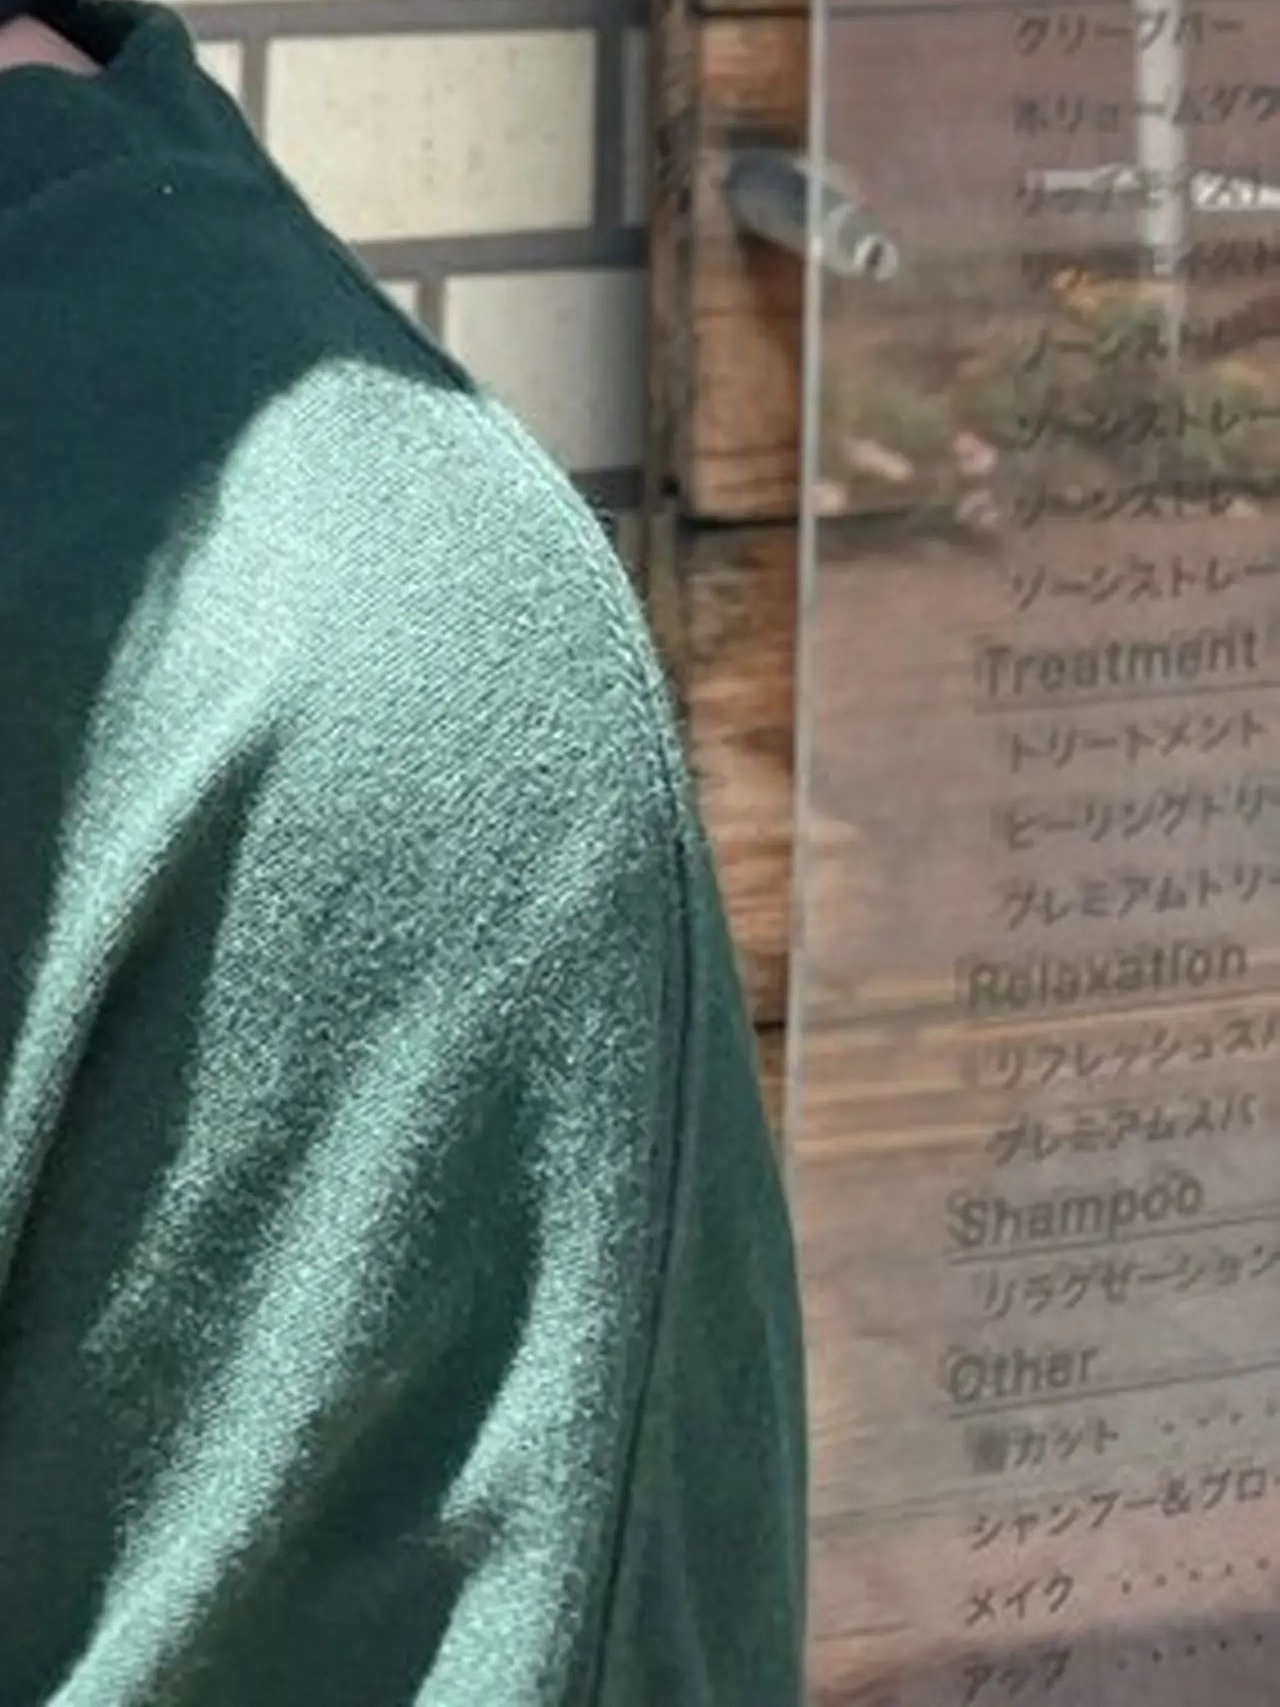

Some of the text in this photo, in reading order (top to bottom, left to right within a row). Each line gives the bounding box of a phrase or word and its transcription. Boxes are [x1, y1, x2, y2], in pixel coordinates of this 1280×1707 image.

[984, 625, 1260, 699] Treatment
[1009, 709, 1268, 775] トリートメント
[966, 939, 1248, 1011] Relaxation
[952, 1167, 1205, 1248] Shampoo
[949, 1345, 1099, 1405] Other
[970, 1415, 1119, 1474] カット
[962, 1571, 1074, 1628] メイク
